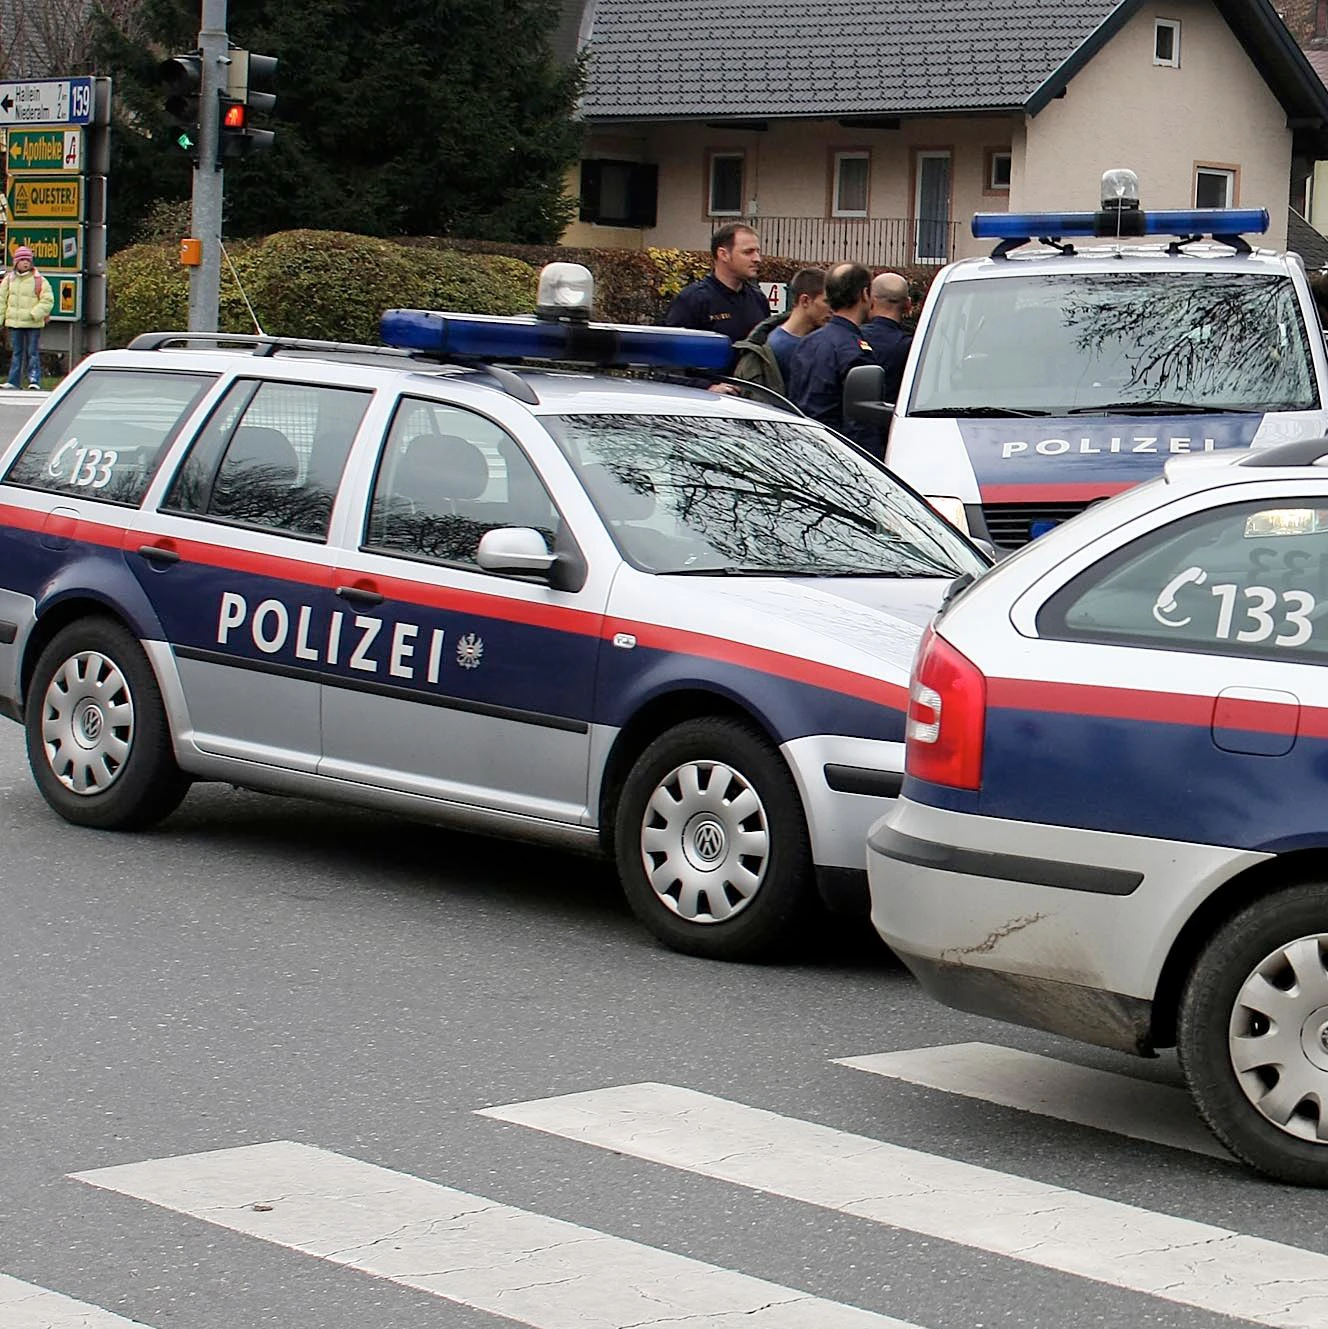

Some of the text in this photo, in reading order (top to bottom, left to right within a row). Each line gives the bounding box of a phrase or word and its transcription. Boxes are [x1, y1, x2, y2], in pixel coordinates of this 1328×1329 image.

[15, 86, 41, 102] Hallein
[57, 83, 63, 101] 7
[72, 85, 91, 117] 159
[15, 104, 50, 120] Niederalm
[56, 103, 63, 120] 2
[23, 136, 63, 167] Apotheke
[31, 187, 76, 206] QUESTER!
[1001, 437, 1216, 459] POLIZEI
[69, 447, 119, 488] 133
[1211, 583, 1316, 648] 133
[217, 592, 446, 684] POLIZEI
